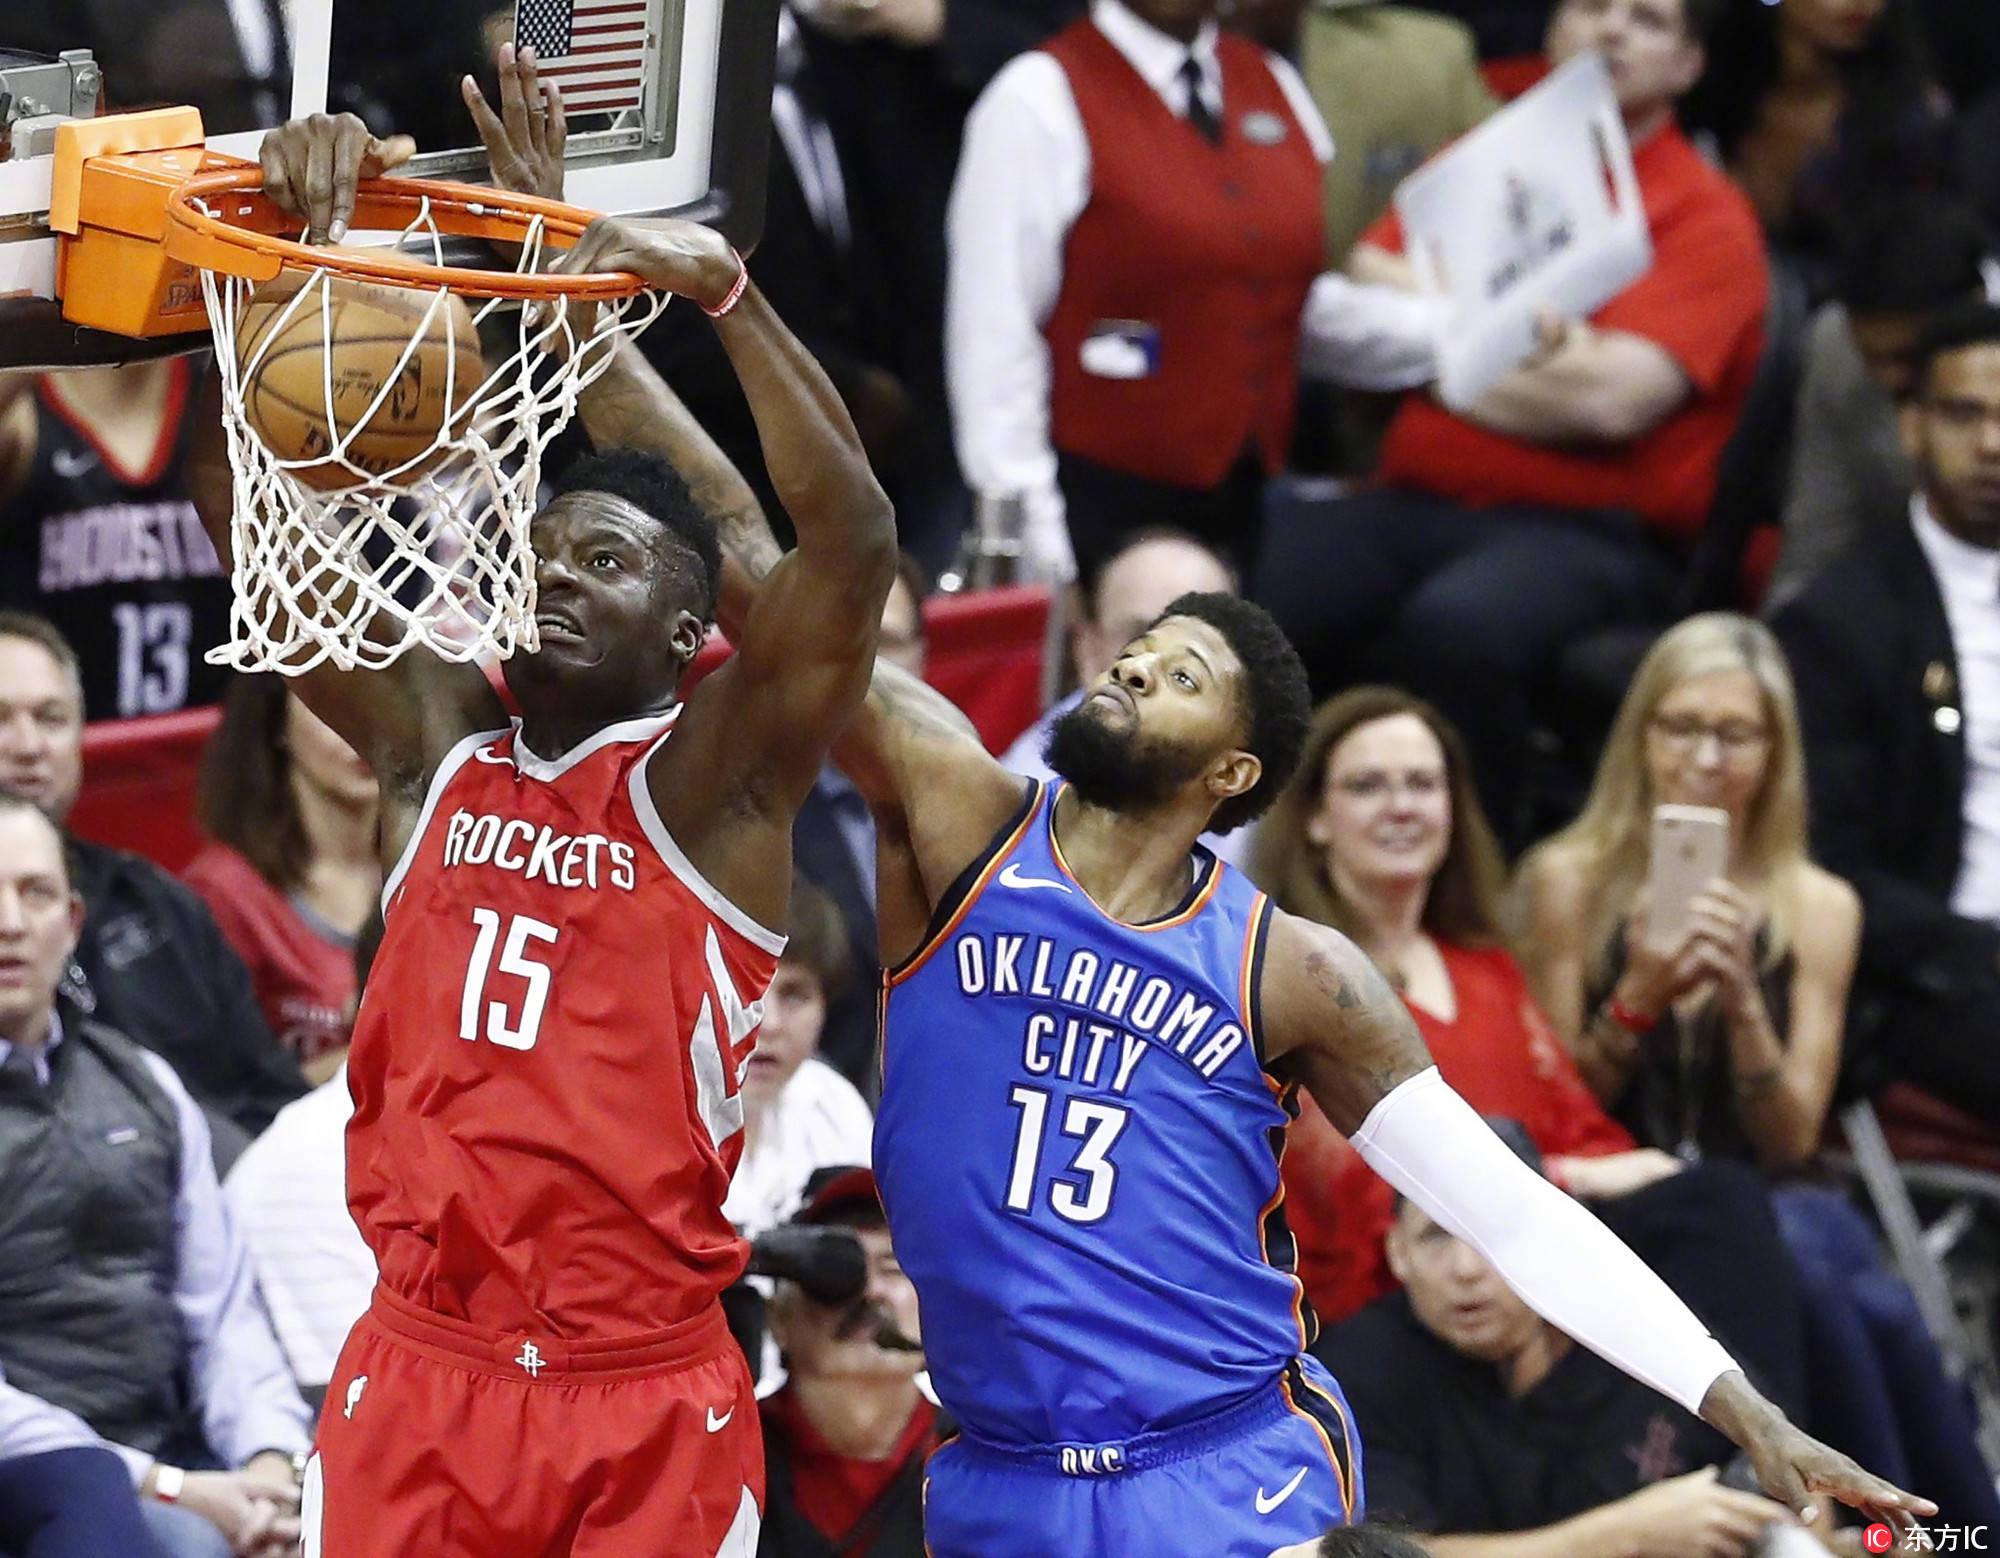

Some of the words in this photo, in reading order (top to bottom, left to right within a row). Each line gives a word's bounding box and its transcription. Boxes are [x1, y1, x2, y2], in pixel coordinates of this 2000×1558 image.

[112, 602, 193, 717] 13
[442, 806, 637, 892] ROCKETS
[458, 905, 561, 1052] 15
[955, 932, 1250, 1083] OKLAHOMA
[1022, 1010, 1152, 1096] CITY
[1001, 1081, 1132, 1225] 13
[1060, 1446, 1124, 1476] OKC
